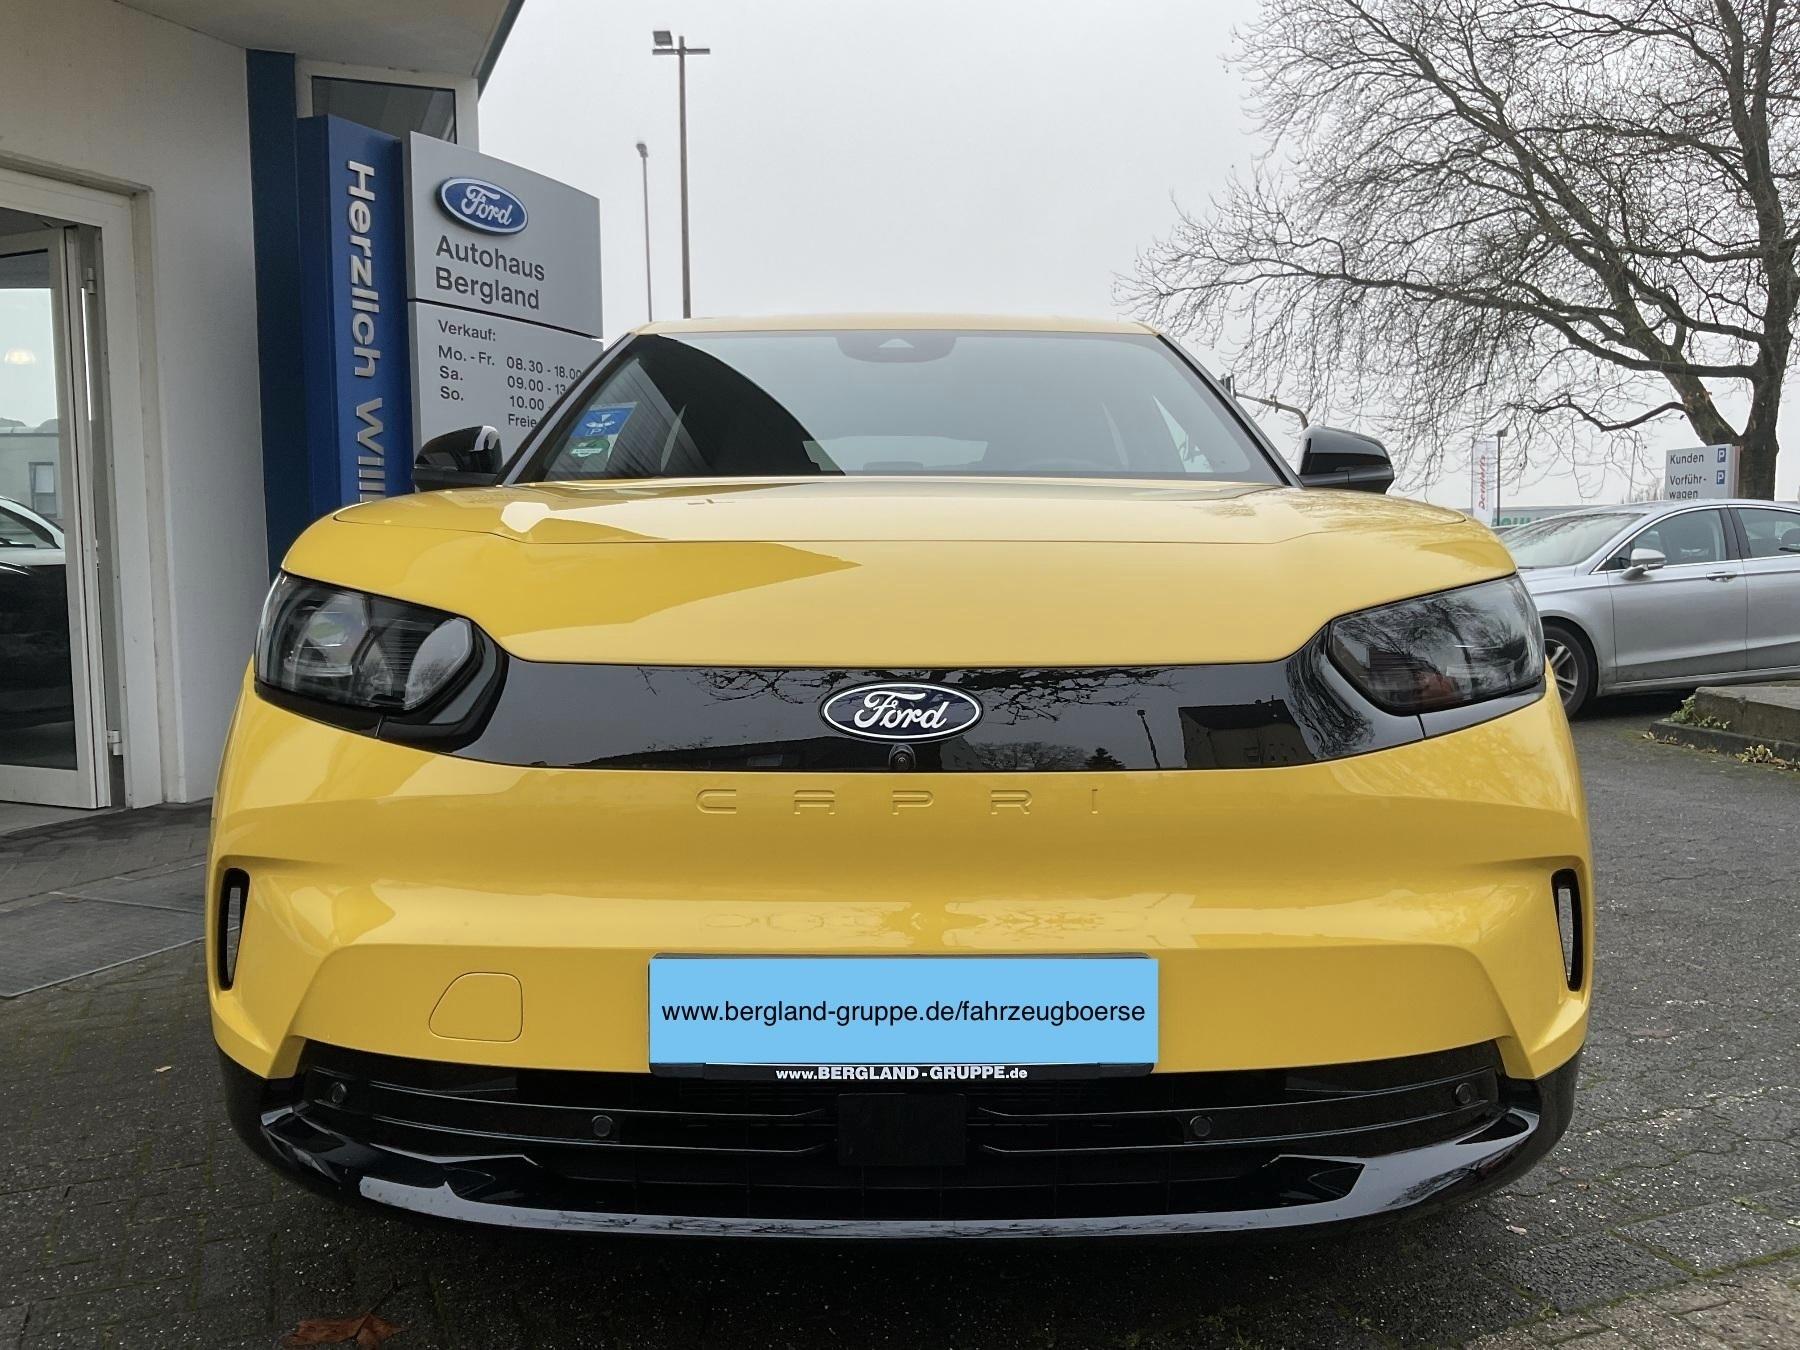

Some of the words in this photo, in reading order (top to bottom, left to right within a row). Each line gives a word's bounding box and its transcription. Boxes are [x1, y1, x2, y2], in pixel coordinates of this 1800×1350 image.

[461, 185, 513, 226] Ford
[347, 160, 381, 378] Herzlich
[435, 234, 545, 282] Autohaus
[435, 266, 540, 310] Bergland
[438, 319, 497, 342] Verkauf:
[438, 344, 467, 362] Mo.
[478, 351, 495, 366] Fr.
[506, 356, 543, 374] 08.30
[439, 365, 464, 381] Sa.
[507, 376, 544, 393] 09.00
[555, 383, 567, 396] 13
[440, 386, 464, 401] So.
[509, 395, 545, 411] 10.00
[508, 413, 537, 428] Freie
[1669, 453, 1704, 464] Kunden
[1669, 473, 1707, 486] Vorführ-
[853, 690, 950, 731] Ford
[695, 788, 1099, 815] CAPRI
